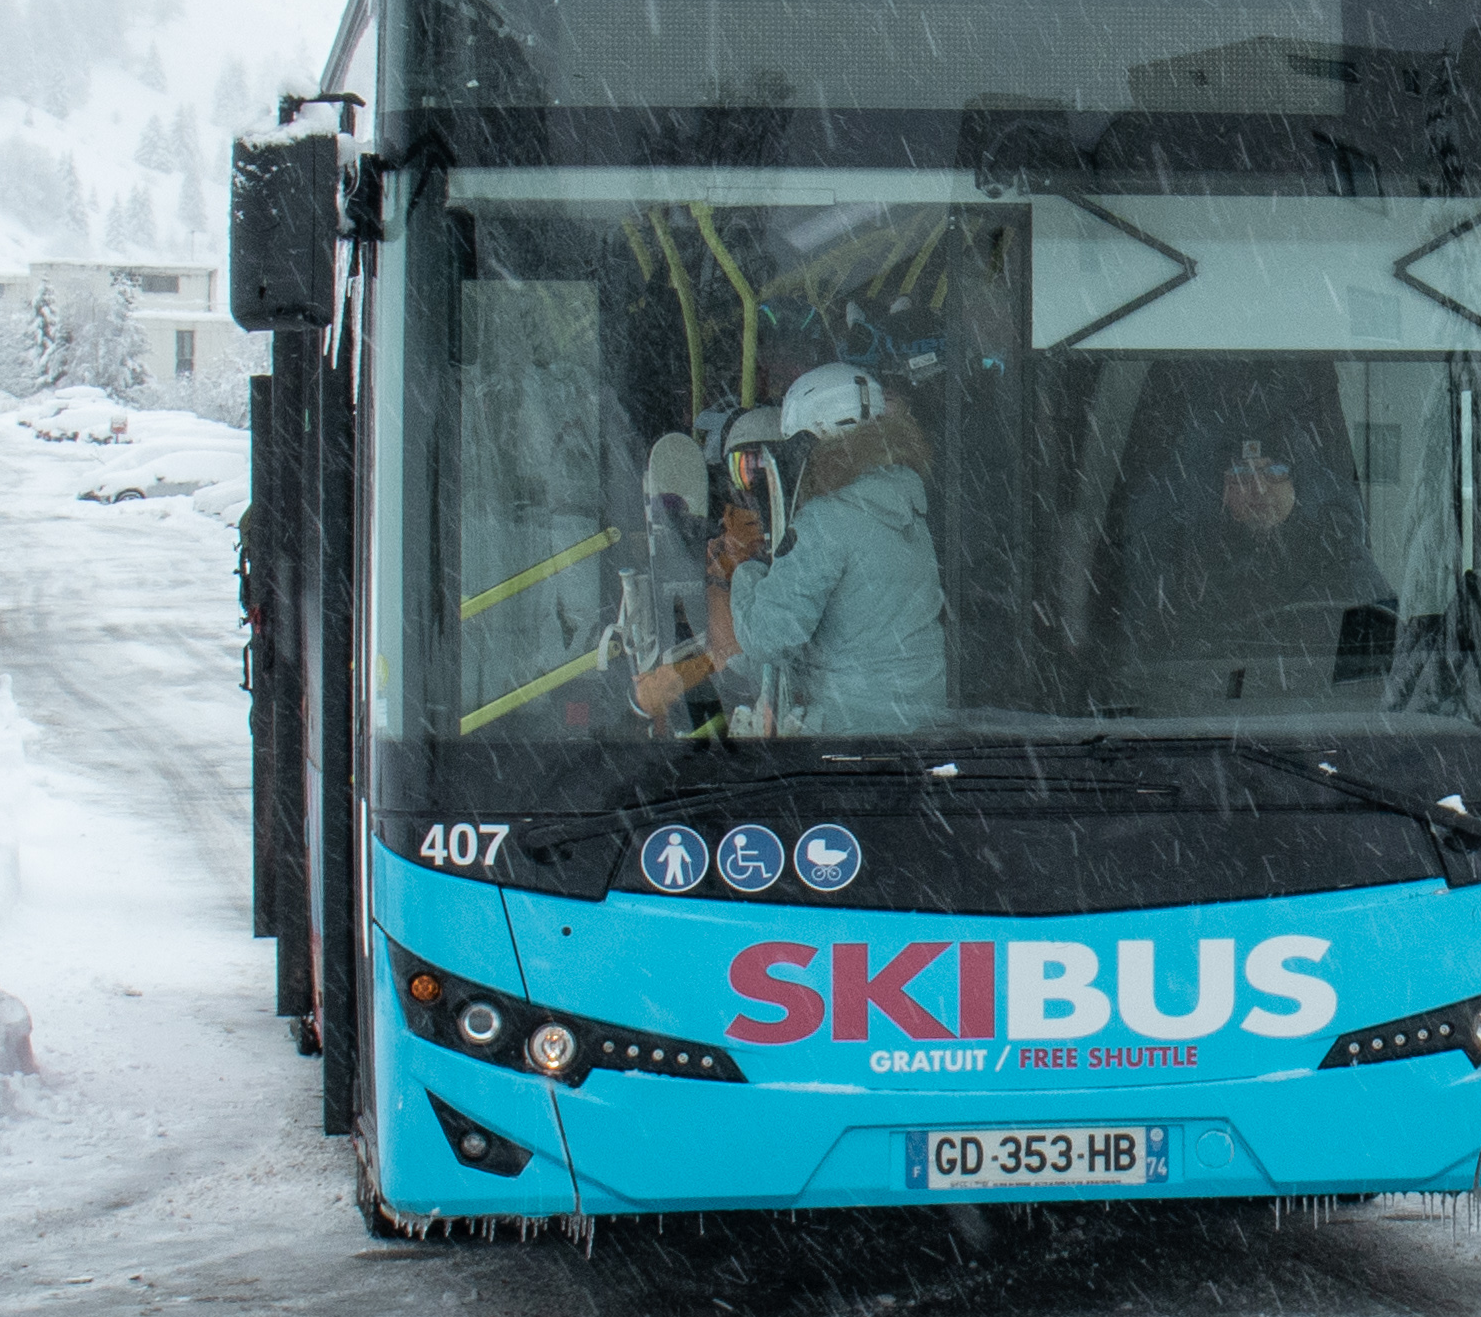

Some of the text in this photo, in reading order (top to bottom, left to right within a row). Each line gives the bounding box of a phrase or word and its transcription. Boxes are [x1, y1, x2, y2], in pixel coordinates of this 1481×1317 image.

[420, 822, 510, 866] 407
[724, 934, 1339, 1045] SKIBUS
[868, 1048, 986, 1074] GRATUIT
[1019, 1046, 1079, 1070] FREE
[1087, 1044, 1198, 1069] SHUTTLE
[912, 1133, 1169, 1179] F GD-353-HB 74
